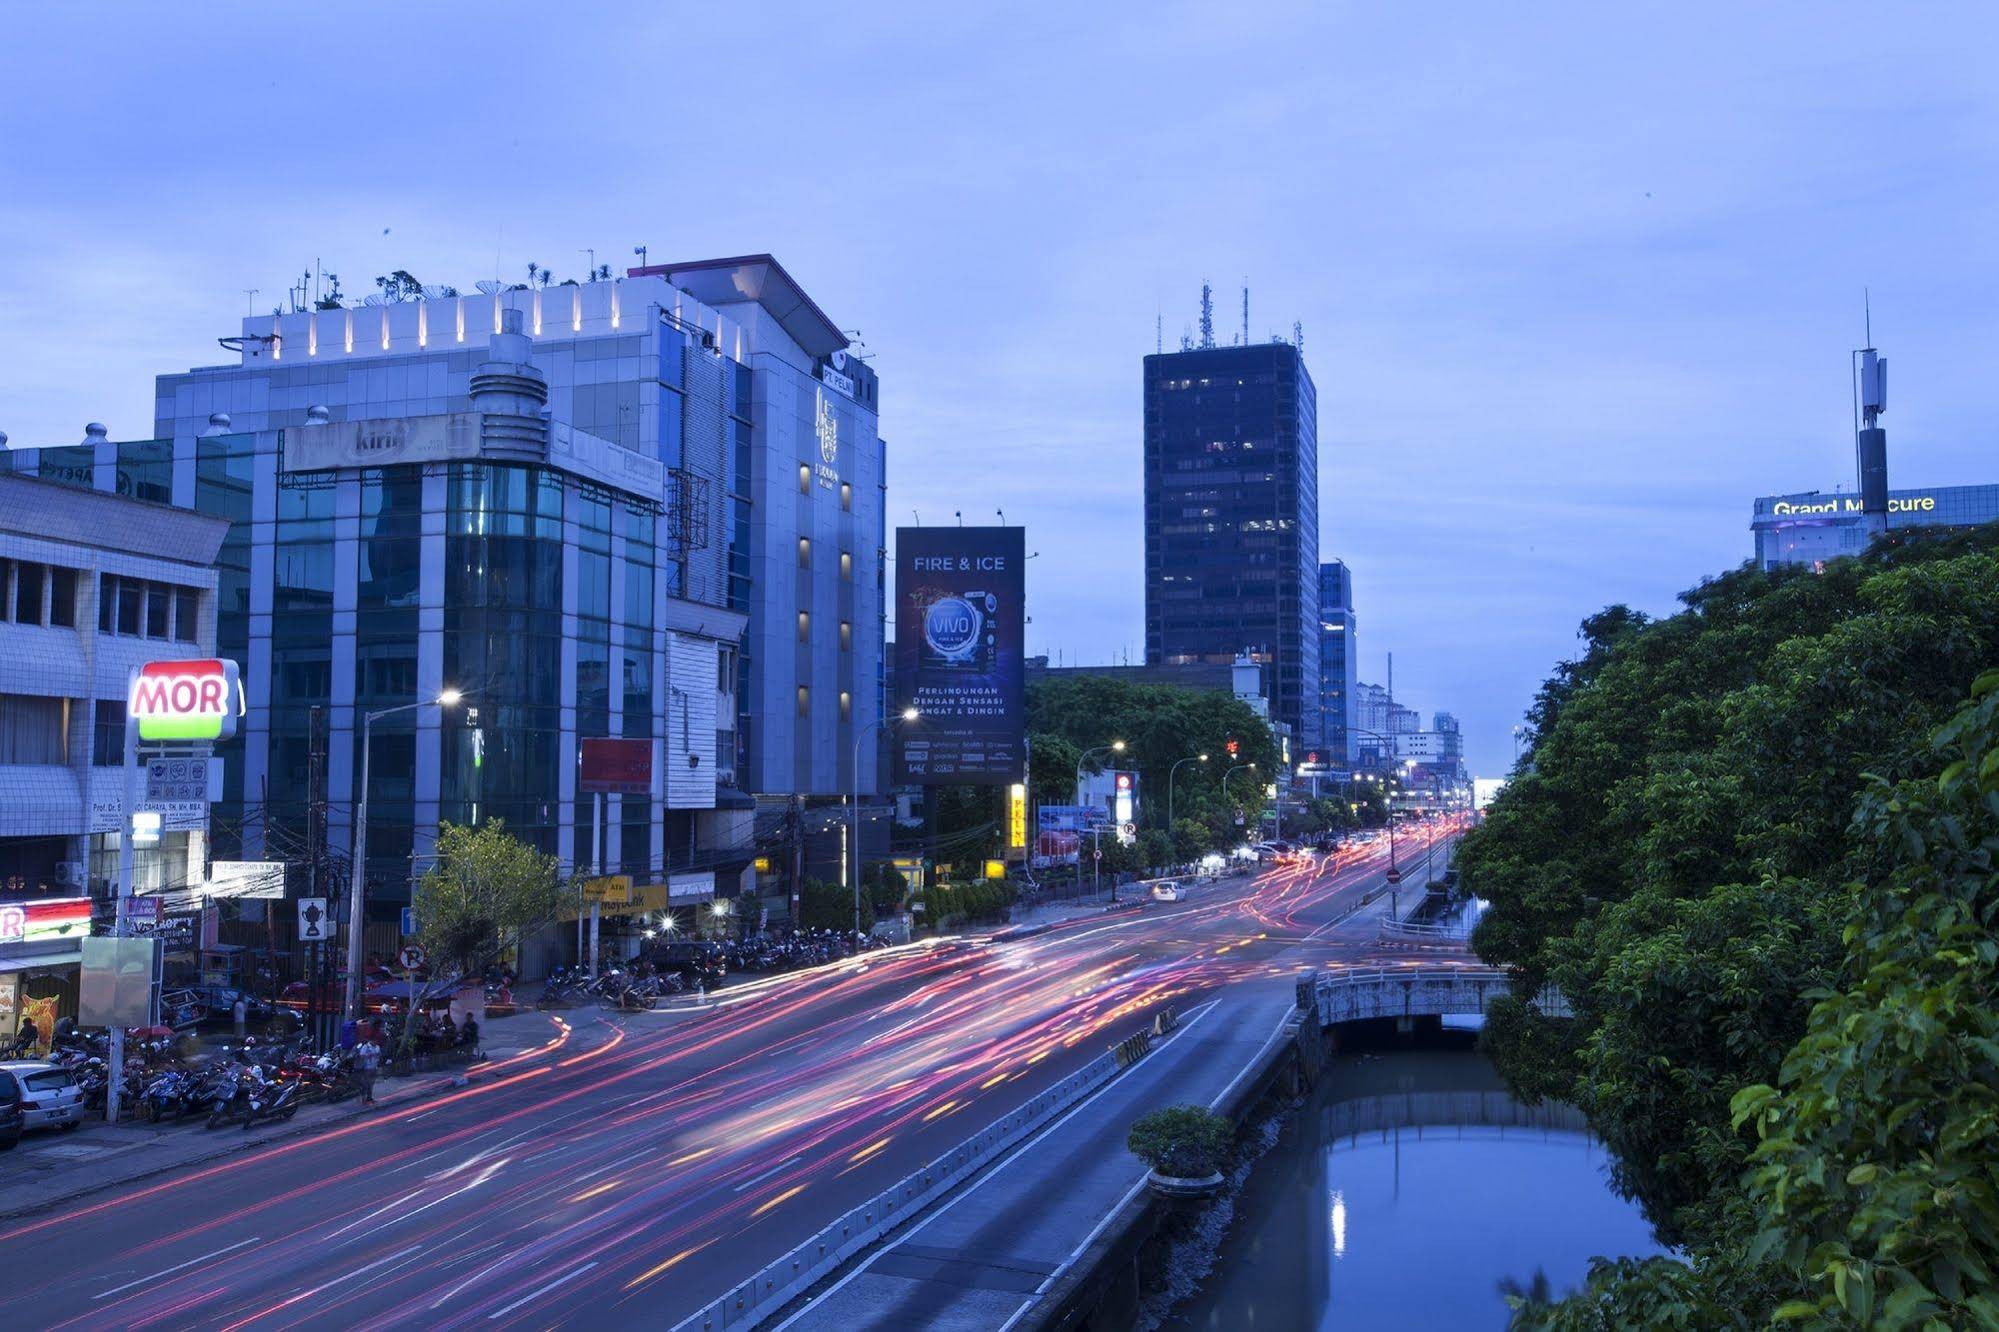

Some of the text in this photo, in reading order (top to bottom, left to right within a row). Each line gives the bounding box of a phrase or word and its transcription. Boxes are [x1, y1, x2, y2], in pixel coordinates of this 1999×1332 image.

[1774, 497, 1935, 515] Grand Mcure
[914, 556, 1005, 571] FIRE & ICE
[933, 617, 969, 633] VIVO
[132, 678, 225, 715] MOR
[918, 687, 998, 695] PERLINDUNGAN
[913, 697, 1003, 705] DENGAN SENSASI
[957, 707, 963, 715] &
[967, 707, 1005, 715] DINGIN
[93, 803, 107, 812] Prof.
